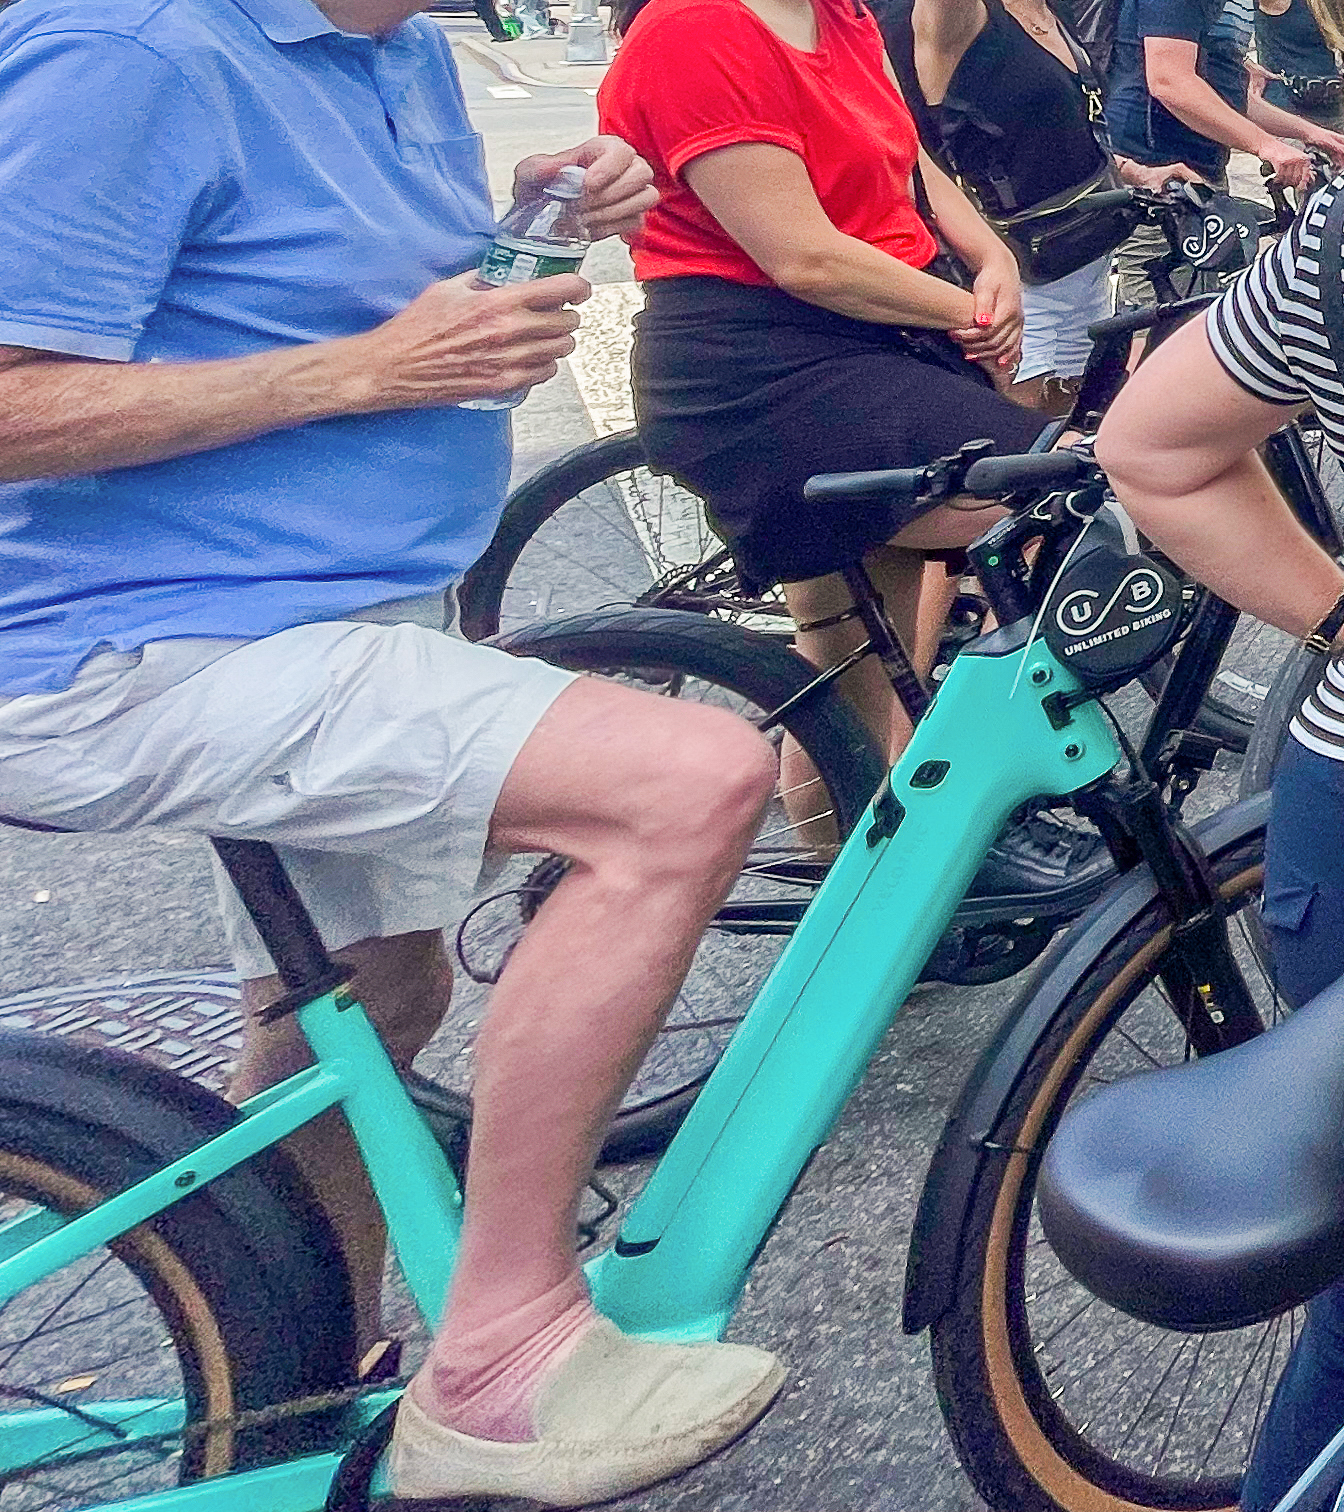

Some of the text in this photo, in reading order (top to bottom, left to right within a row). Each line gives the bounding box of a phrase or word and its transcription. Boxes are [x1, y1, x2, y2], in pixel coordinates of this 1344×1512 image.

[1130, 580, 1152, 602] B
[1070, 601, 1093, 623] U
[1064, 608, 1172, 657] UNLIMITED BIKING
